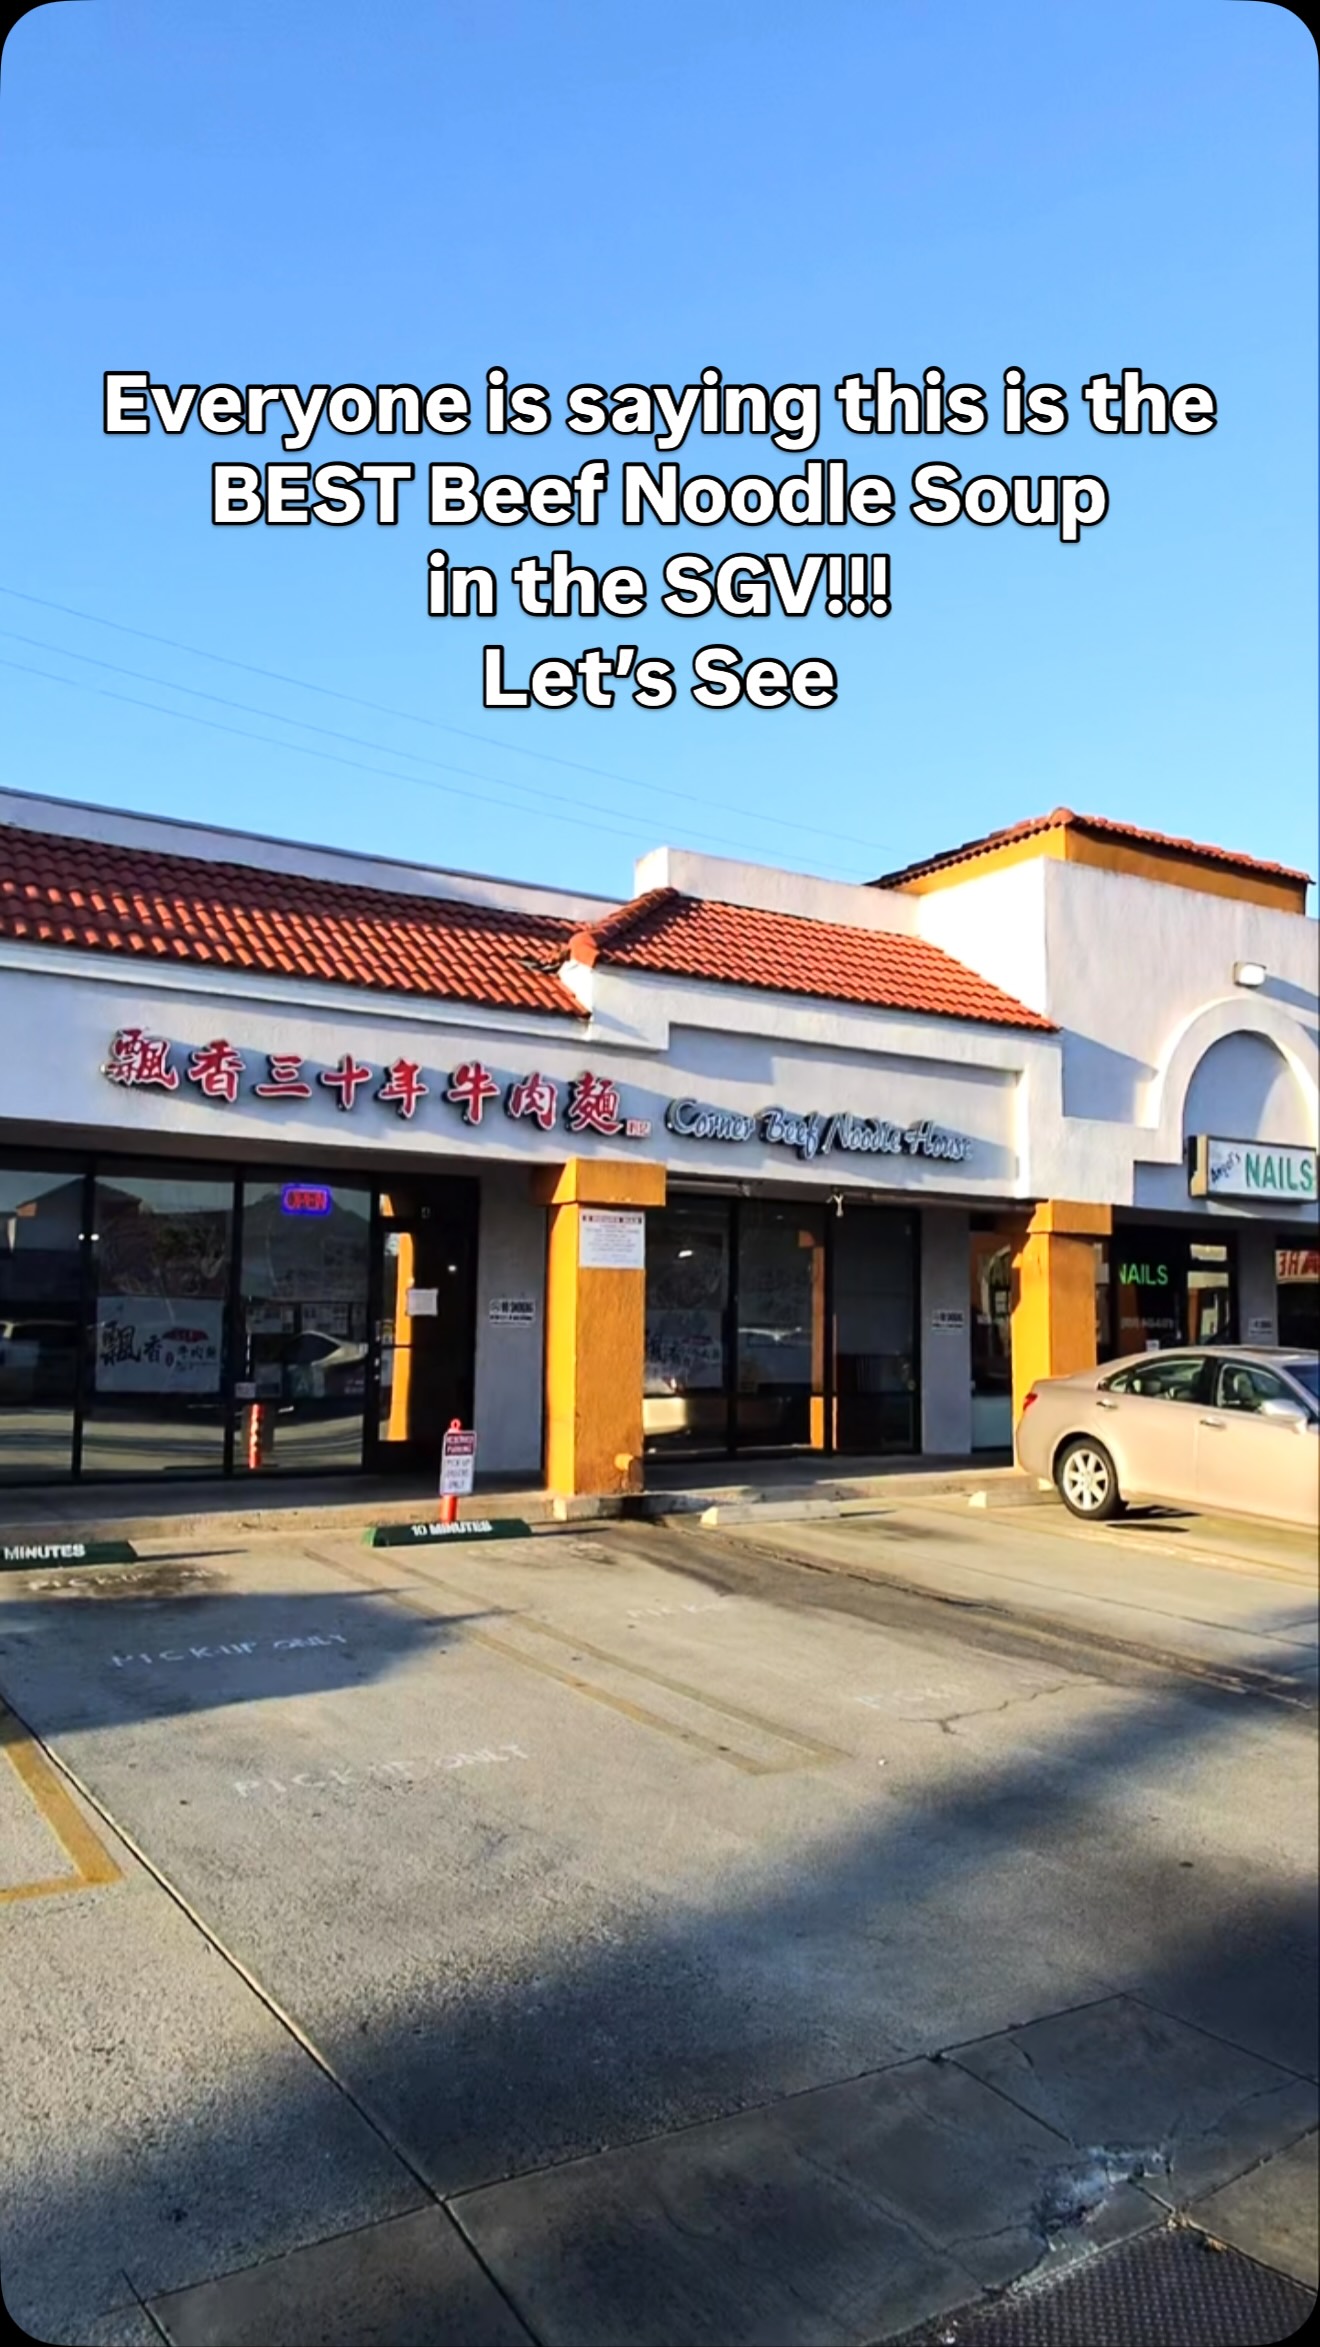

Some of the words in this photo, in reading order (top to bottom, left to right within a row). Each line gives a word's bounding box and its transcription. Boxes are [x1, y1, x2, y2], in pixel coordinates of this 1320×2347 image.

[666, 1098, 757, 1140] Corner
[760, 1107, 820, 1160] Beef
[821, 1112, 902, 1153] Noodle
[905, 1120, 974, 1161] House
[1245, 1152, 1313, 1192] NAILS
[288, 1190, 328, 1210] OPEN
[1119, 1263, 1169, 1285] NAILS
[411, 1524, 427, 1537] 10
[429, 1520, 493, 1536] MINUTES
[3, 1543, 86, 1561] MINUTES
